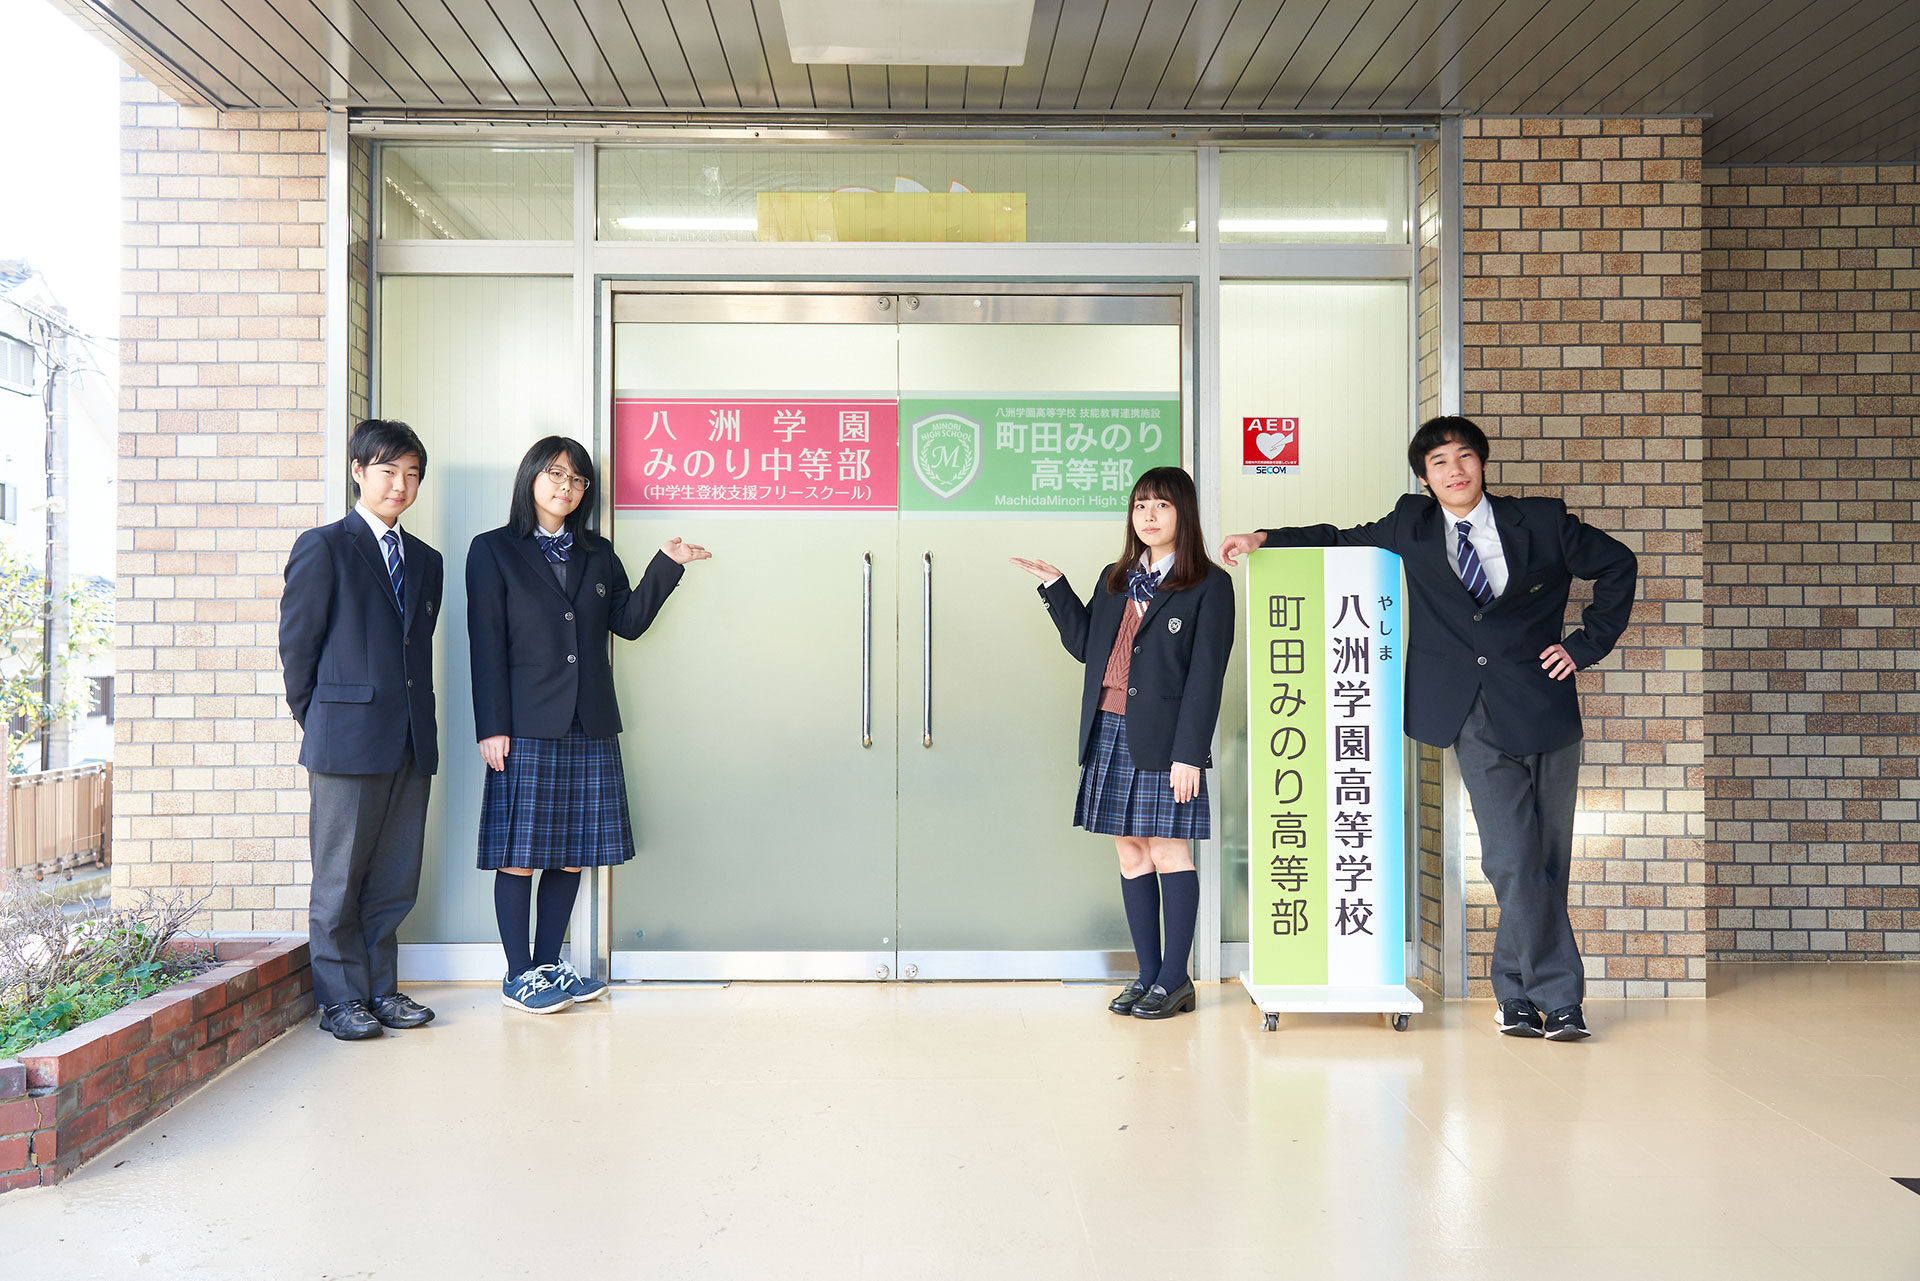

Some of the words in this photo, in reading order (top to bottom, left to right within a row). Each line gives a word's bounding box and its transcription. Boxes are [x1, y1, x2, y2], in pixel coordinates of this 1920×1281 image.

[995, 407, 1077, 418] 八洲学園高等学校
[1080, 407, 1161, 419] 技能教育連携施設
[1247, 418, 1295, 431] AED
[643, 409, 870, 443] 八洲学園
[921, 430, 941, 441] HIGH
[941, 429, 972, 442] SCHOOL
[932, 422, 961, 431] MINORI
[996, 421, 1162, 454] 町田みのり
[643, 447, 871, 481] みのり中等部
[1031, 457, 1134, 491] 高等部
[1256, 466, 1287, 475] SECOM
[643, 484, 872, 501] (中学生登校支援フリースクール)
[995, 495, 1085, 506] MachidaMinori
[1089, 495, 1117, 508] High
[1377, 595, 1394, 661] やしま
[1269, 595, 1309, 936] 町田みのり高等部
[1332, 594, 1374, 936] 八洲学園高等学校
